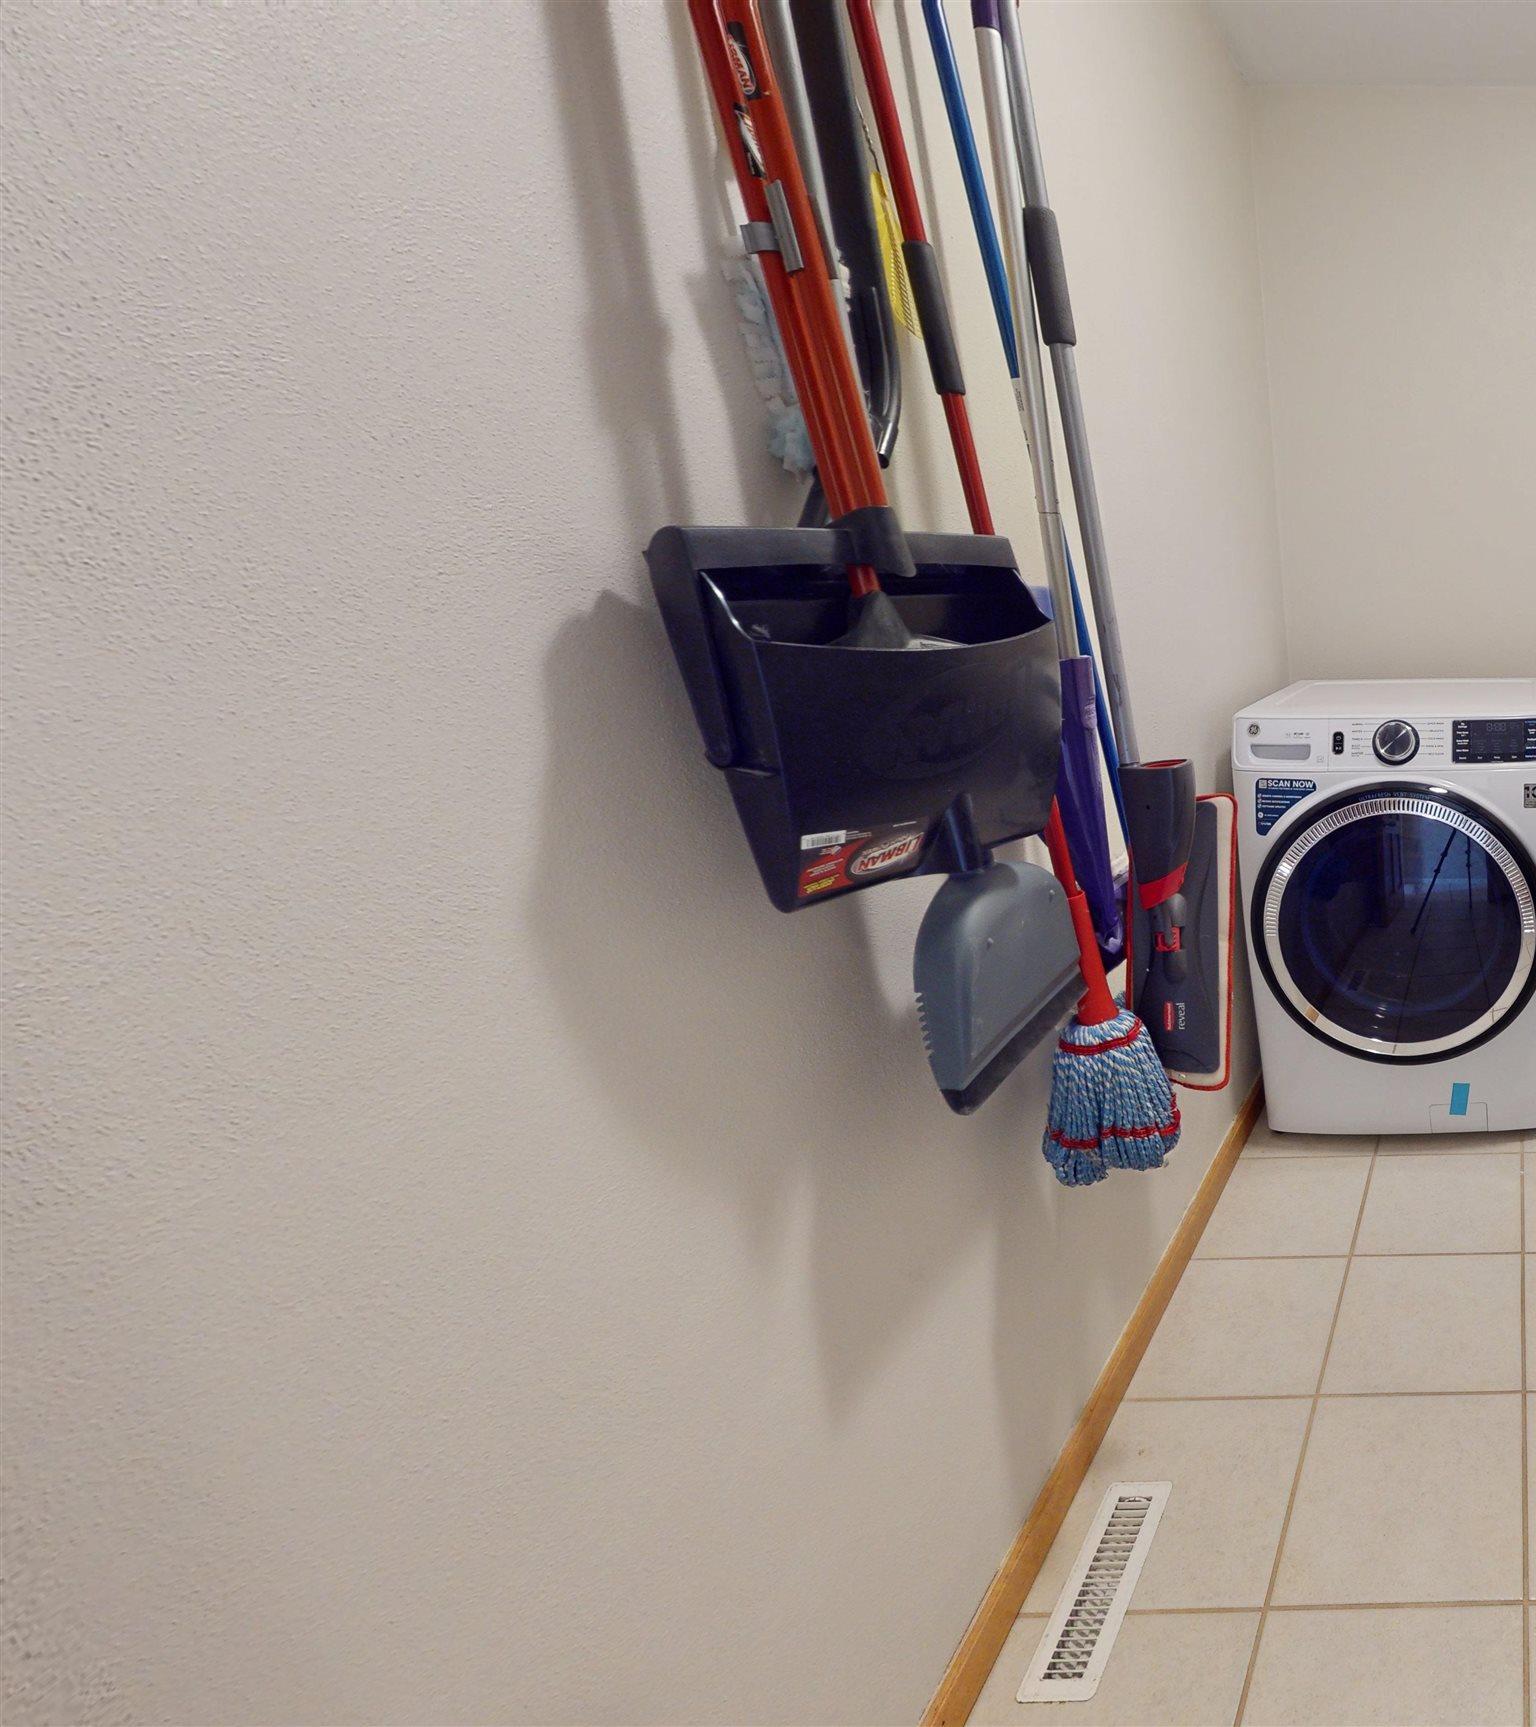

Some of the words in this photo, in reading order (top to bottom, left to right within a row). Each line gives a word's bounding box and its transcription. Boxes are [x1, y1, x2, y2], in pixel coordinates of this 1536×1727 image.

[1292, 780, 1314, 788] NOW
[857, 834, 924, 873] LIBMAN
[1175, 1002, 1185, 1030] reveal
